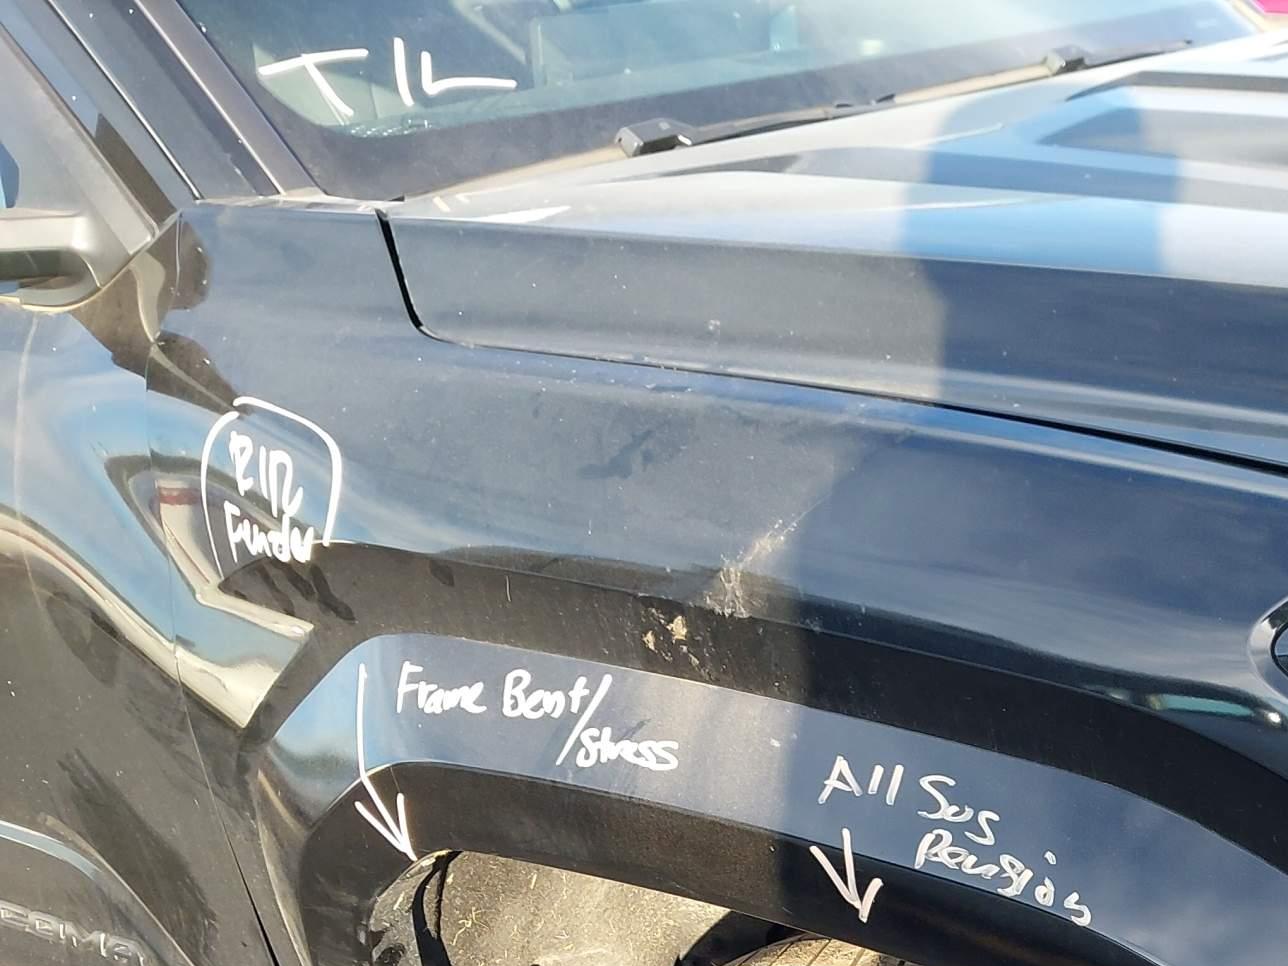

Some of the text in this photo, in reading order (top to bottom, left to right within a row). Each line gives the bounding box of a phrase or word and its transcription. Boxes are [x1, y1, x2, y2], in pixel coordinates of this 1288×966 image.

[223, 500, 314, 563] Fender
[396, 660, 487, 714] Frame
[817, 754, 1001, 846] All Sus
